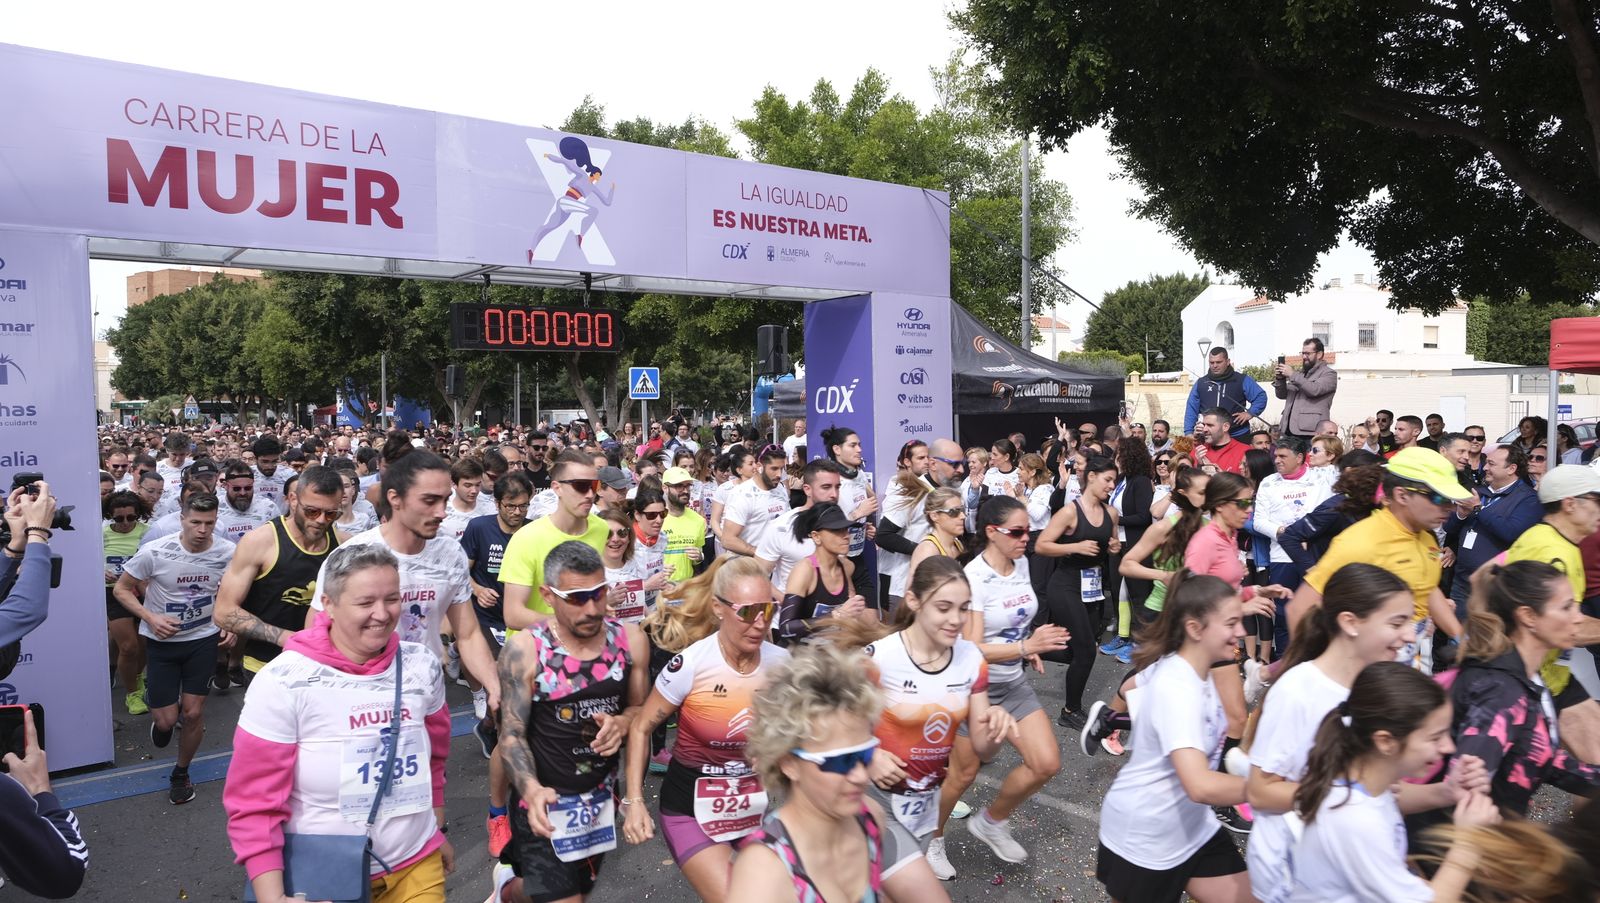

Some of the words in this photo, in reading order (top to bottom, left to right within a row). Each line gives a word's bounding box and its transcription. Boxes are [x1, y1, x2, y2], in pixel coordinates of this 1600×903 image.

[124, 98, 289, 144] CARRERA
[300, 122, 340, 150] DE
[351, 129, 387, 157] LA
[106, 137, 404, 229] MUJER
[741, 182, 762, 202] LA
[767, 186, 848, 213] IGUALDAD
[713, 209, 736, 228] ES
[740, 212, 820, 238] NUESTRA
[824, 223, 872, 243] META.
[722, 243, 750, 260] CDX
[484, 308, 613, 347] 00:00:00
[906, 347, 933, 355] cajamar
[900, 368, 924, 385] CASI
[815, 378, 859, 413] CDX
[908, 395, 932, 403] vithas
[904, 423, 932, 434] aqualia
[1284, 492, 1307, 500] MUJER
[228, 525, 253, 533] MUJER
[177, 575, 209, 583] MUJER
[401, 590, 436, 602] MUJER
[1003, 594, 1033, 609] MUJER
[177, 608, 203, 620] 133
[712, 795, 751, 814] 924
